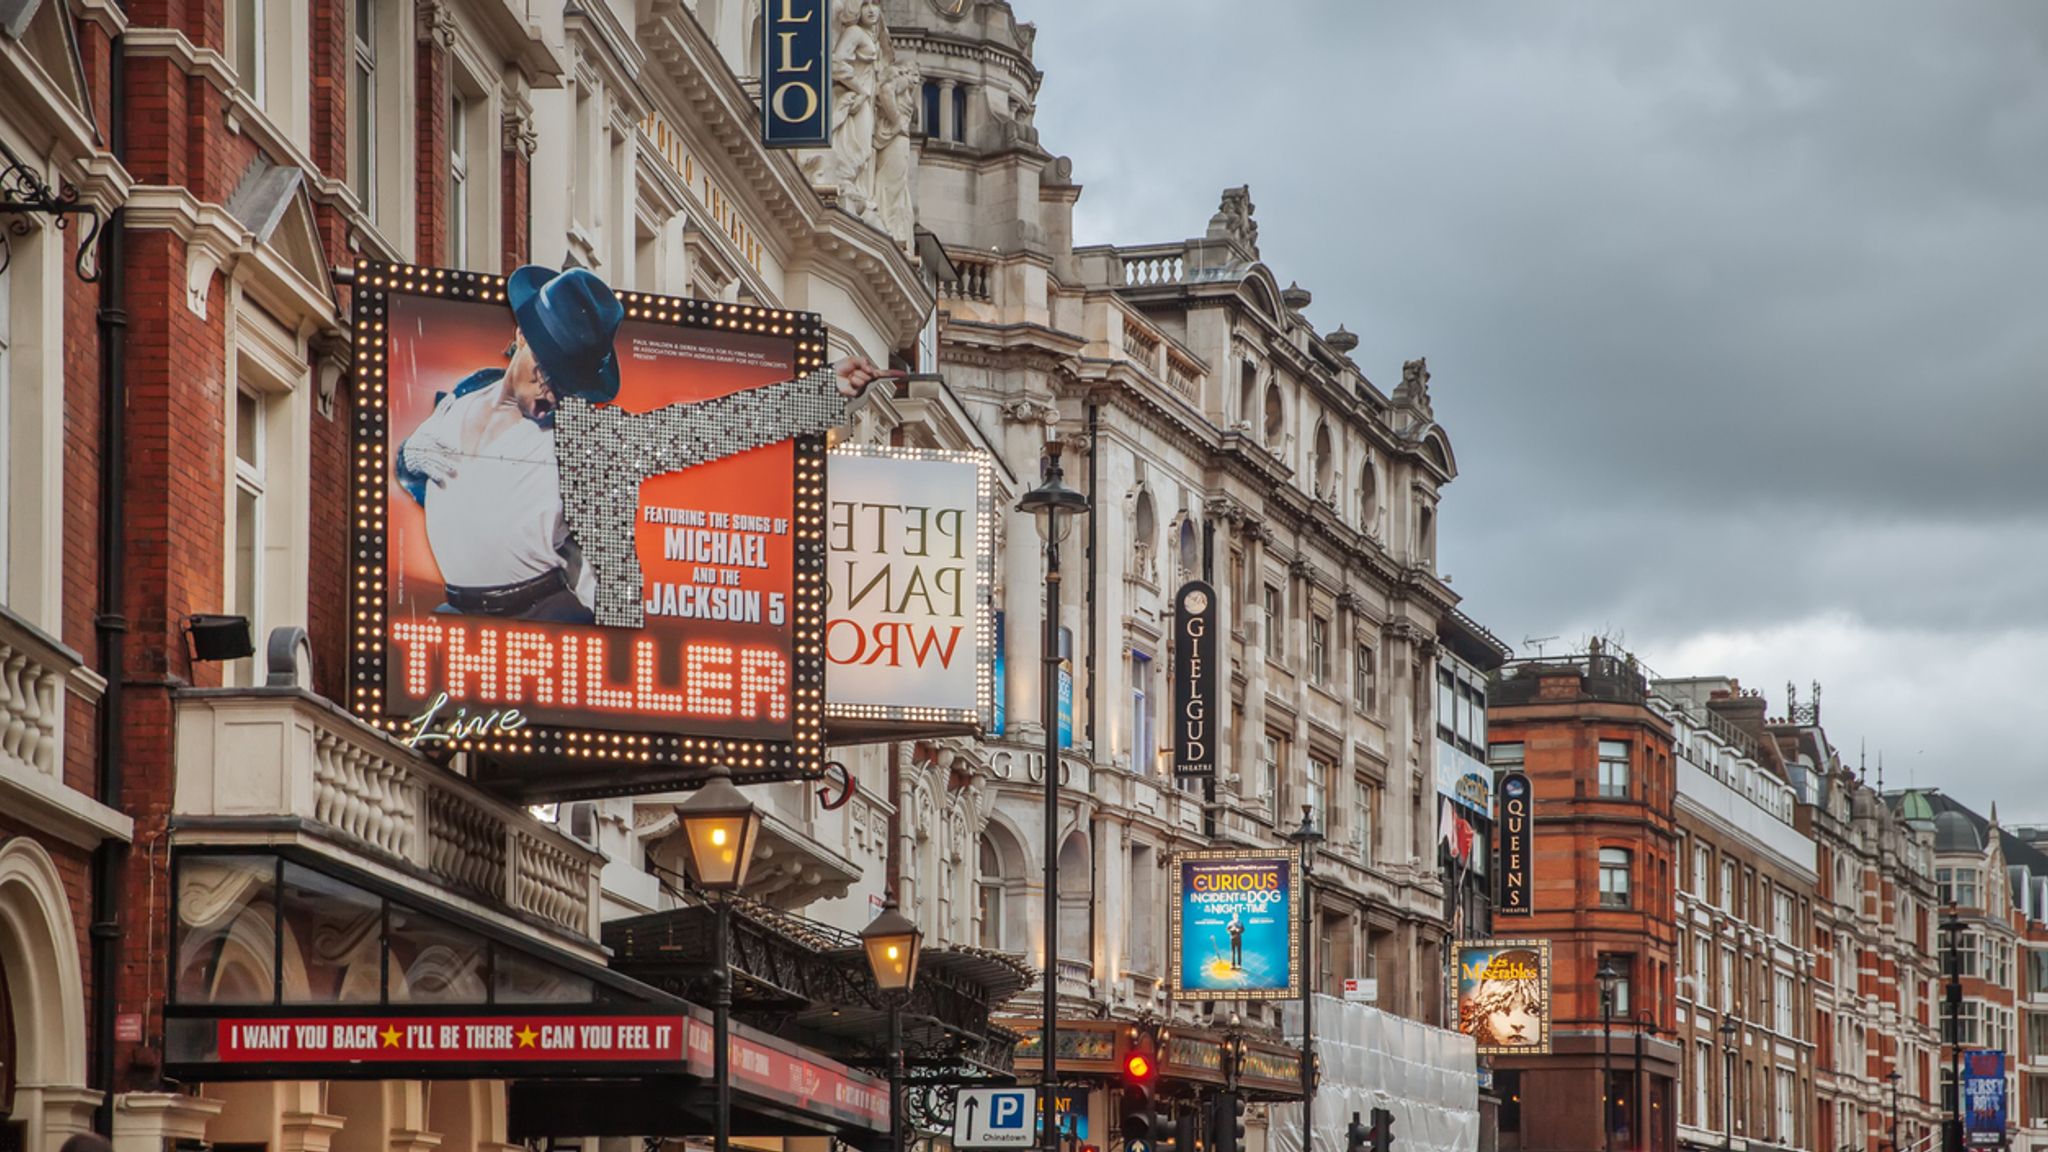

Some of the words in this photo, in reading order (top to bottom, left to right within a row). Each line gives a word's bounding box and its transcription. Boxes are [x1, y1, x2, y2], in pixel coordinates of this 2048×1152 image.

[704, 174, 763, 276] THEATRE
[644, 505, 706, 528] FEATURING
[709, 511, 729, 530] THE
[732, 514, 771, 533] SONGS
[774, 518, 789, 535] OF
[664, 527, 769, 568] MICHAEL
[692, 566, 717, 585] AND
[720, 568, 740, 586] THE
[646, 582, 761, 623] JACKSON
[768, 592, 785, 625] 5
[393, 622, 787, 720] THRILLER
[1186, 617, 1205, 762] GIELGUD
[409, 692, 526, 748] Live
[1177, 764, 1212, 772] THEATRE
[1507, 799, 1526, 906] QUEENS
[1193, 872, 1279, 891] CURIOUS
[1190, 892, 1239, 904] INCIDENT
[1247, 890, 1281, 903] DOG
[1211, 903, 1268, 914] NIGHT-TIME
[1462, 962, 1537, 980] Misérables
[1488, 954, 1508, 968] Les
[231, 1025, 238, 1049] I
[242, 1025, 290, 1049] WANT
[295, 1025, 328, 1049] YOU
[333, 1025, 378, 1049] BACK
[406, 1025, 434, 1049] I'LL
[440, 1025, 460, 1049] BE
[465, 1025, 513, 1049] THERE
[541, 1025, 575, 1049] CAN
[579, 1025, 612, 1049] YOU
[617, 1025, 650, 1049] FEEL
[655, 1025, 672, 1049] IT
[997, 1097, 1018, 1125] P
[983, 1134, 1026, 1142] Chinatown
